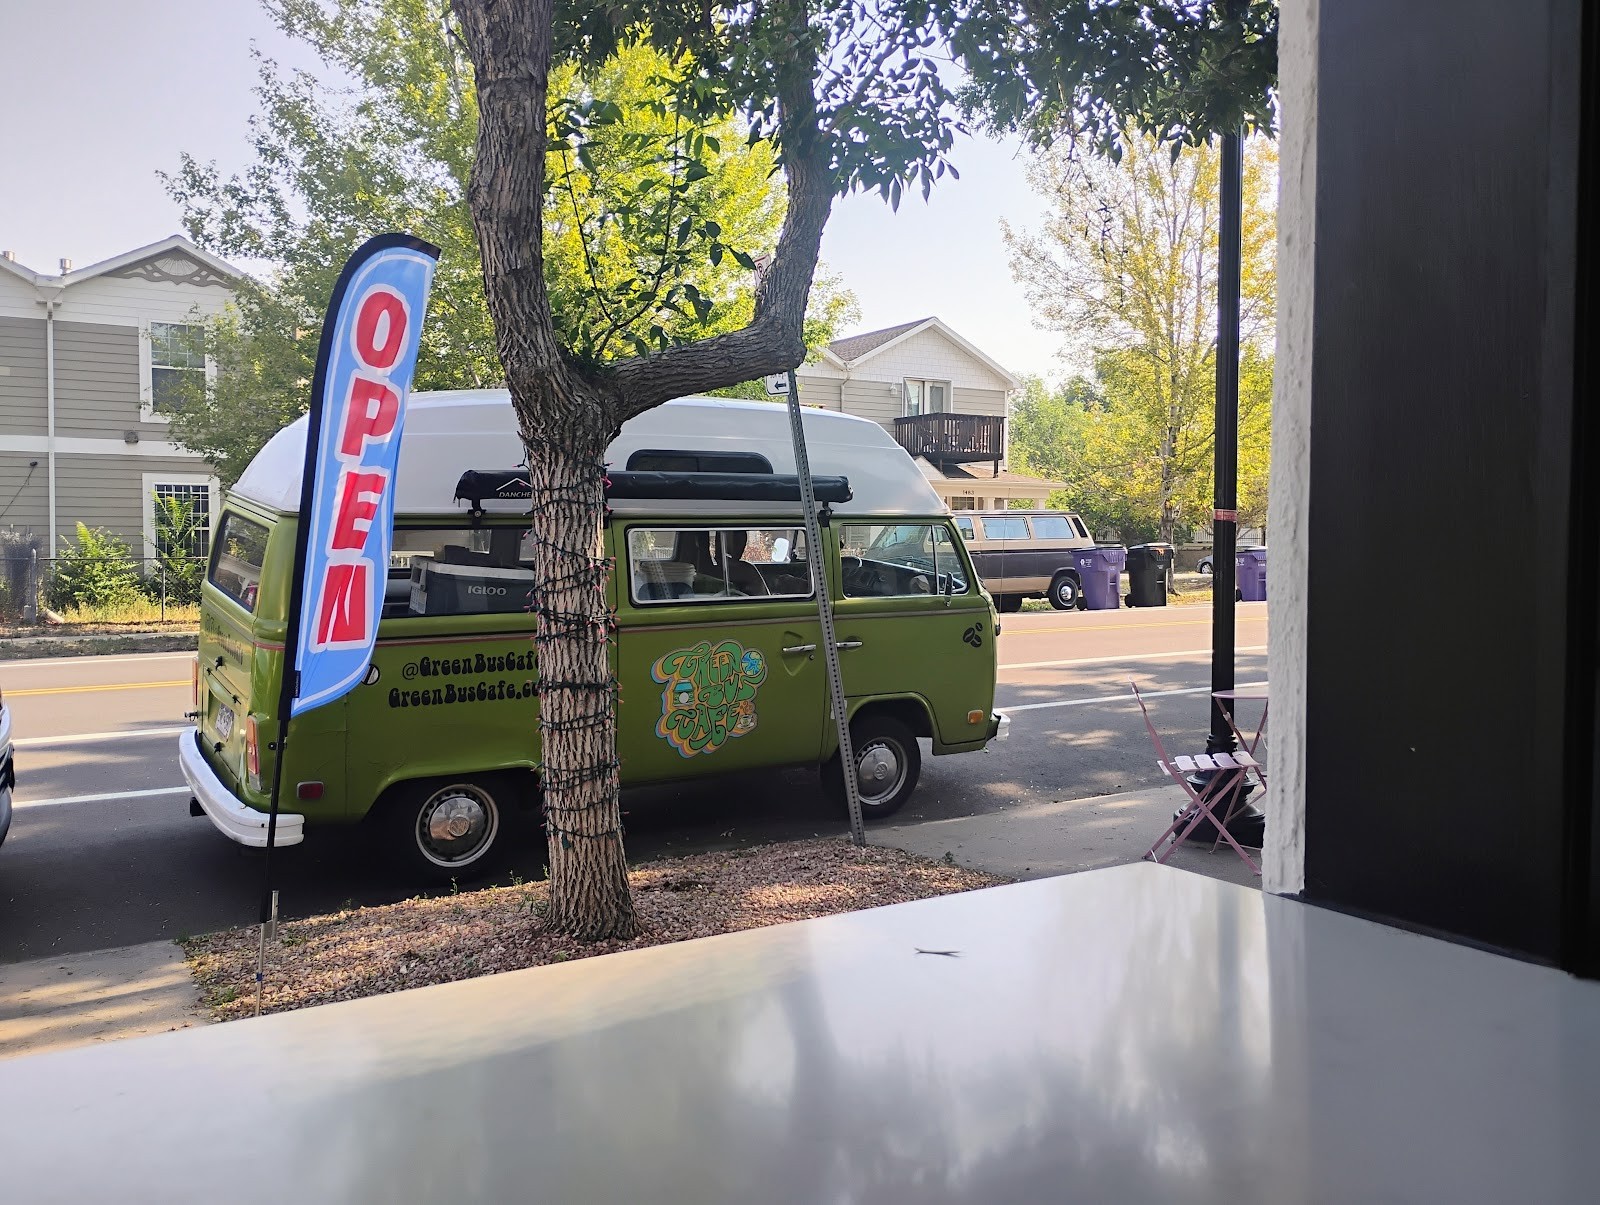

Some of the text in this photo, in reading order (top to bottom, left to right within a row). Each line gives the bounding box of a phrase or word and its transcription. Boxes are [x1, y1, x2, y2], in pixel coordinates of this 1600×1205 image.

[316, 290, 408, 645] OPEN
[467, 585, 507, 596] IGLOO
[662, 641, 742, 690] GREEN
[698, 668, 766, 708] BUS
[666, 703, 740, 750] CAFE
